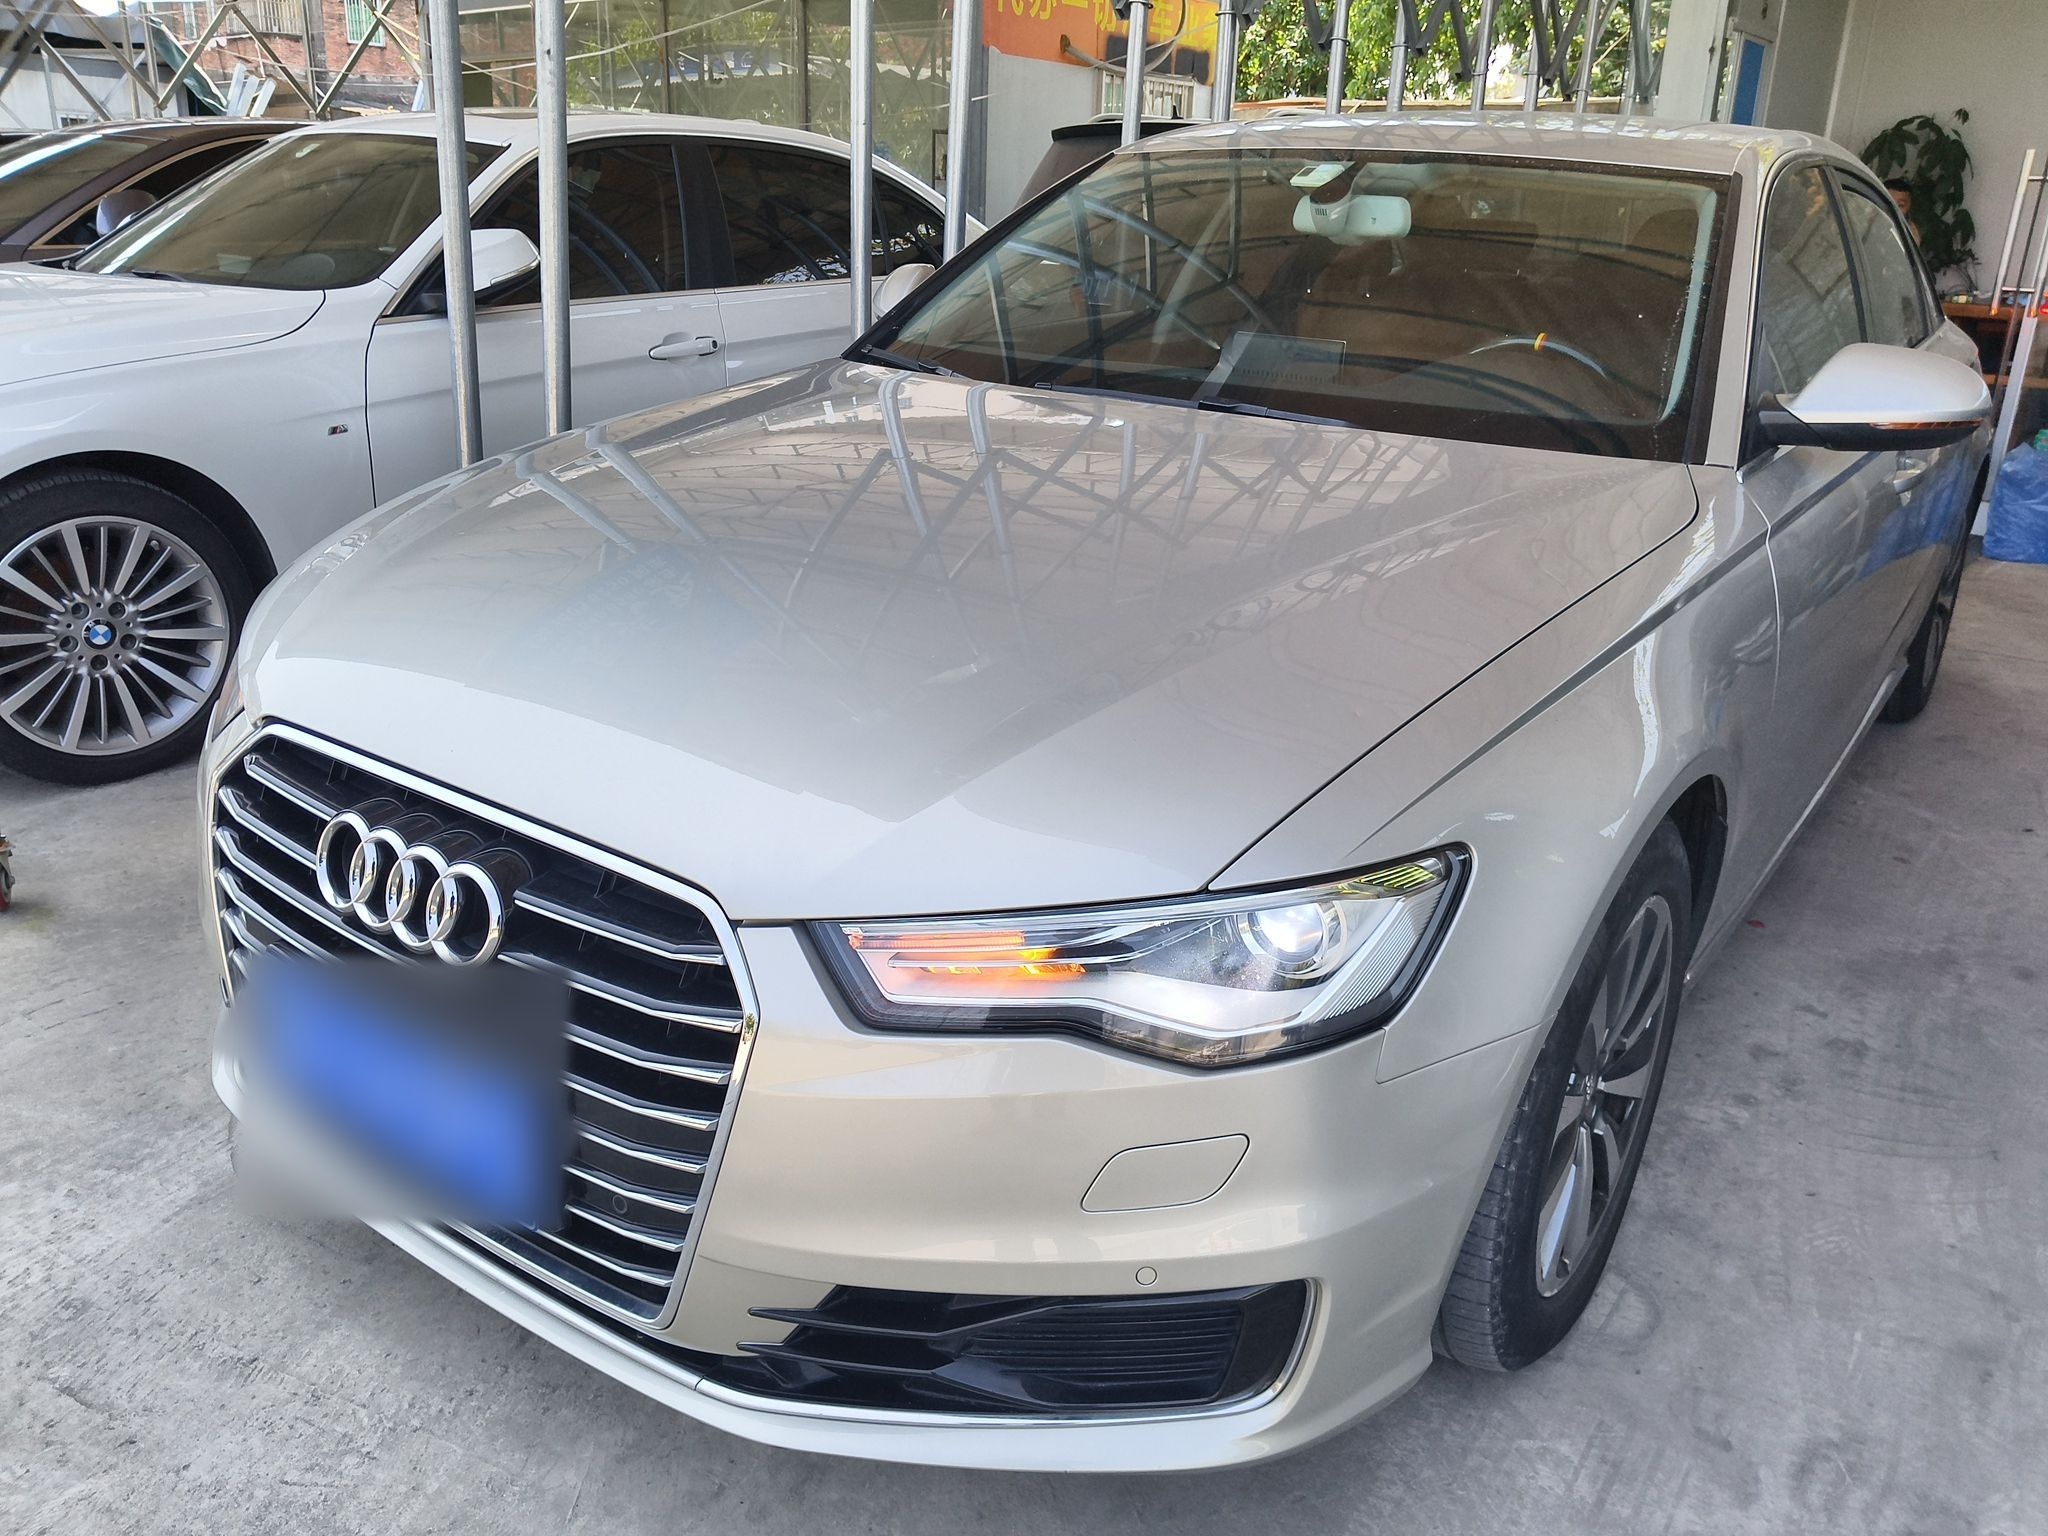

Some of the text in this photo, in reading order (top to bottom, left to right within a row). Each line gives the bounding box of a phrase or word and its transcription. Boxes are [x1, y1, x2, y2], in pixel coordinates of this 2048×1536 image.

[998, 0, 1219, 50] 一切车业务
